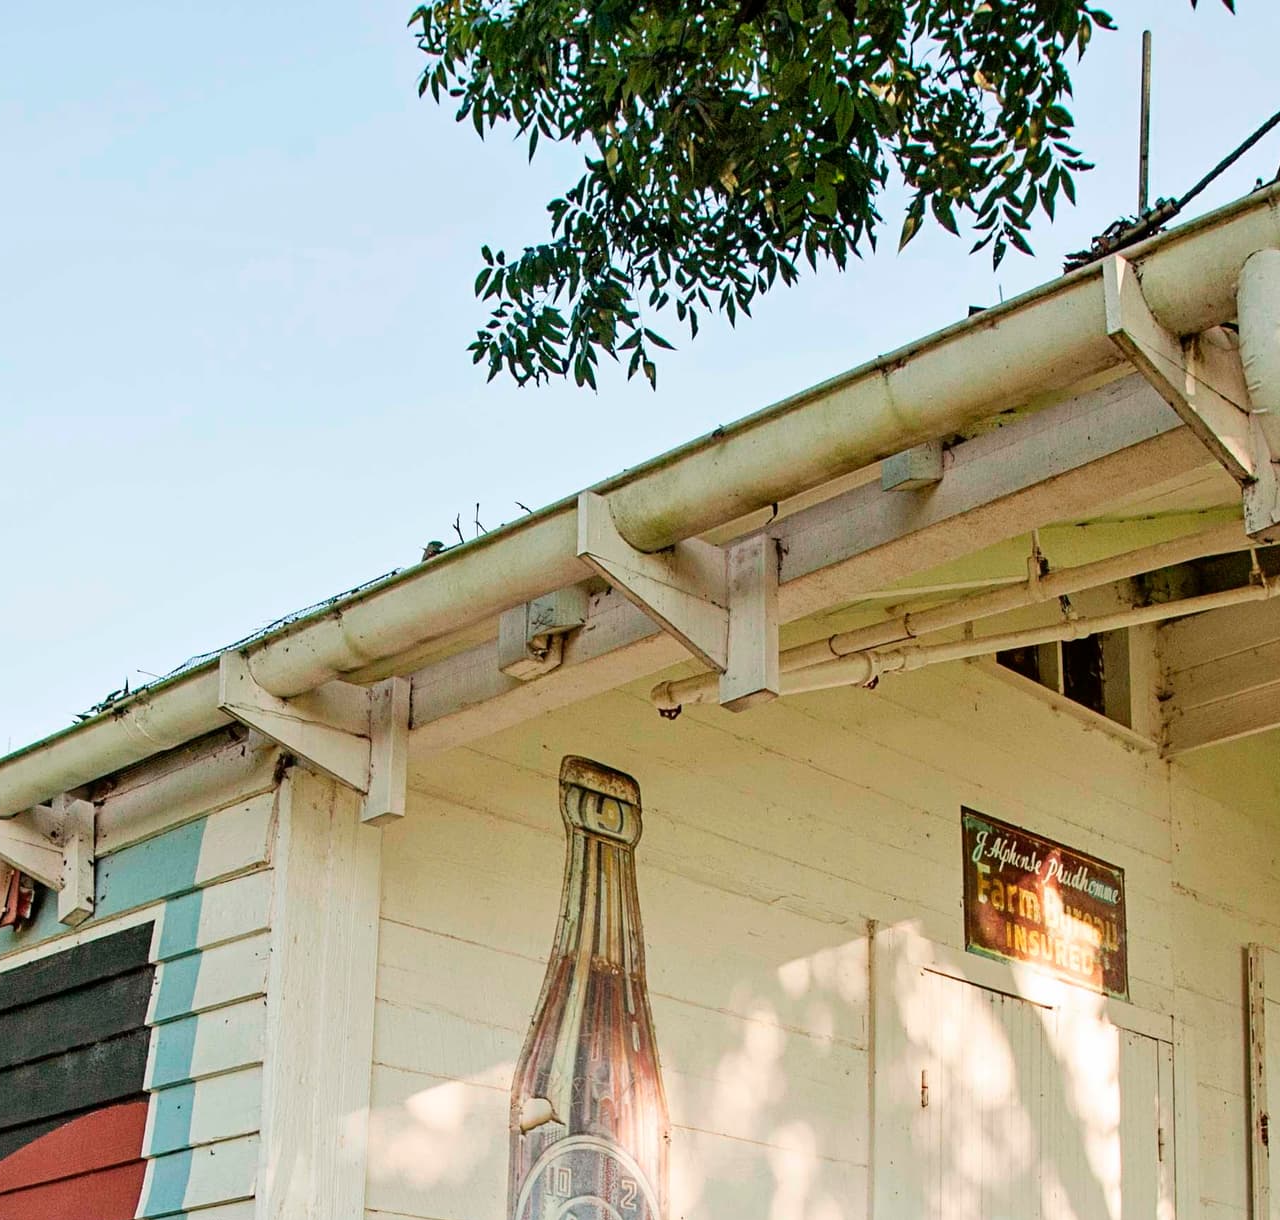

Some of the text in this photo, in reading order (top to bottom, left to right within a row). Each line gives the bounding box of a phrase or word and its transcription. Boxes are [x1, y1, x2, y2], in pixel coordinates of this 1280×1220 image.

[977, 862, 1041, 924] Farm
[1042, 858, 1119, 905] Prudhomme
[1006, 921, 1094, 975] INSURED
[621, 1180, 638, 1211] 2
